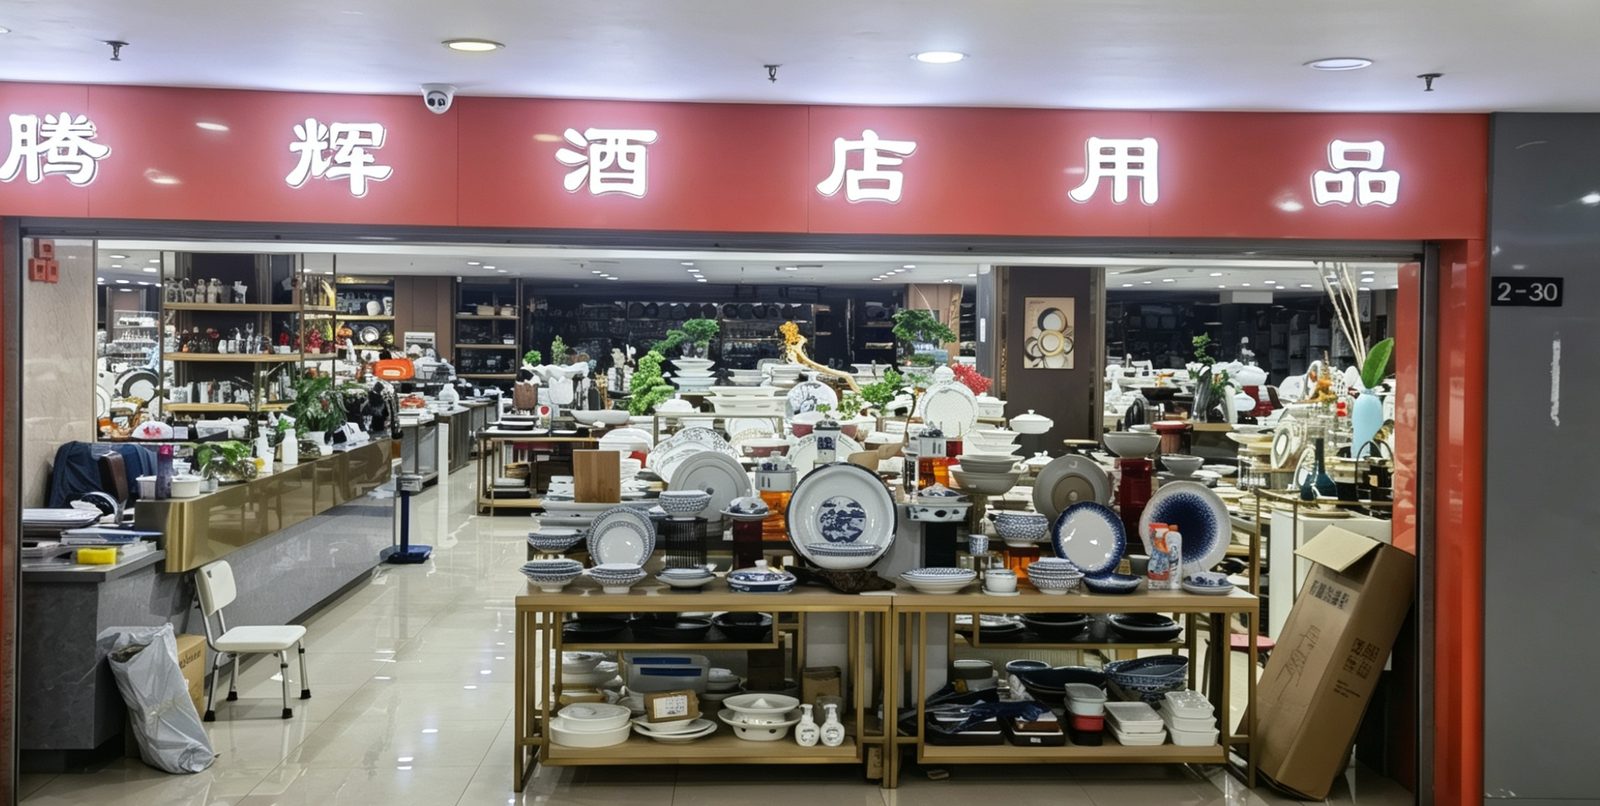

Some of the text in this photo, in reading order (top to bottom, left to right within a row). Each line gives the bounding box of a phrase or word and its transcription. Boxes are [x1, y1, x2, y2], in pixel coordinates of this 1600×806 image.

[0, 112, 1401, 208] 腾辉酒店用品
[1497, 281, 1558, 302] 2-30
